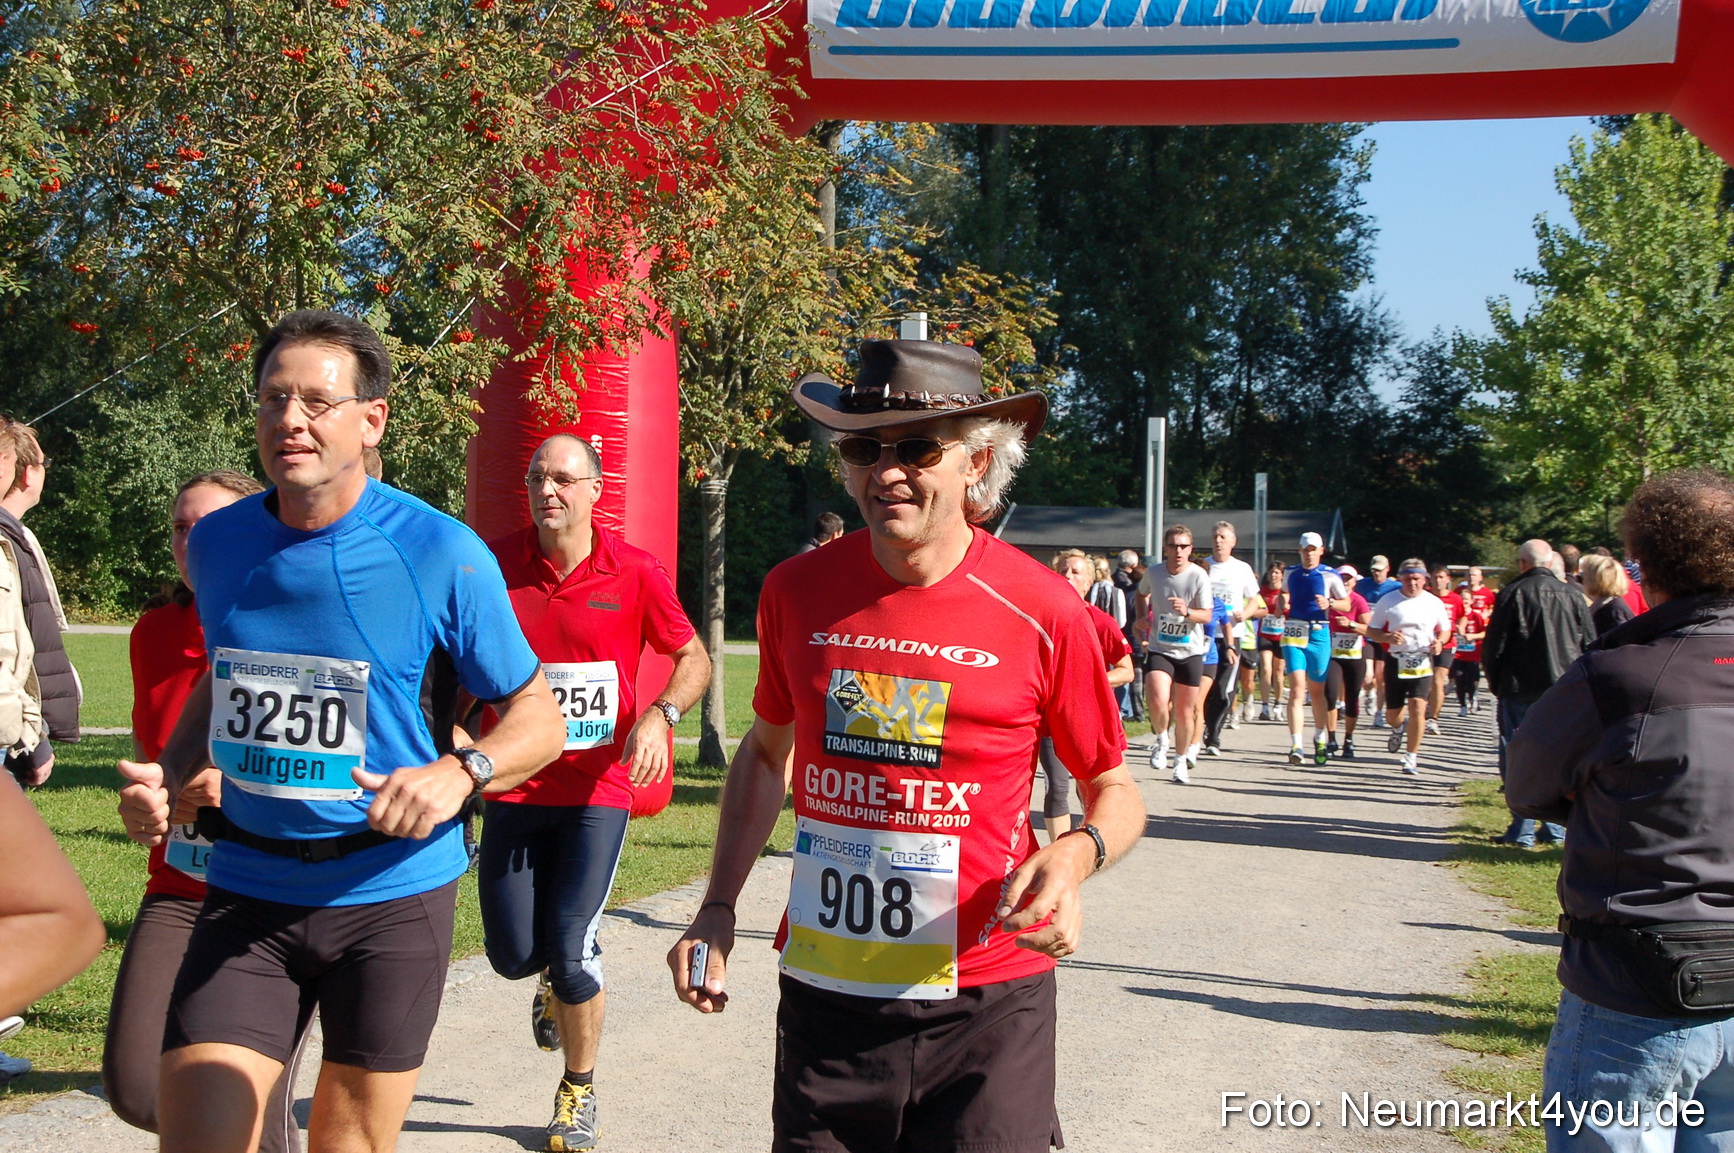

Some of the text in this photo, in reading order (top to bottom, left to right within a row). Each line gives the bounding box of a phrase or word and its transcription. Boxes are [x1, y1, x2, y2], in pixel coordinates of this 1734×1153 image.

[1161, 622, 1187, 635] 2074
[1284, 626, 1302, 637] 986
[809, 632, 939, 657] SALOMON
[233, 662, 299, 680] PFLEIDERER
[545, 671, 575, 680] EIDERER
[551, 686, 608, 718] 254
[227, 687, 347, 748] 3250
[575, 721, 609, 738] Jörg
[826, 735, 938, 763] TRANSALPINE-RUN
[238, 746, 325, 784] Jürgen
[805, 795, 971, 828] TRANSALPINE-RUN 2010
[813, 834, 872, 860] PFLEIDERER
[891, 852, 940, 866] BOCK
[818, 867, 913, 938] 908
